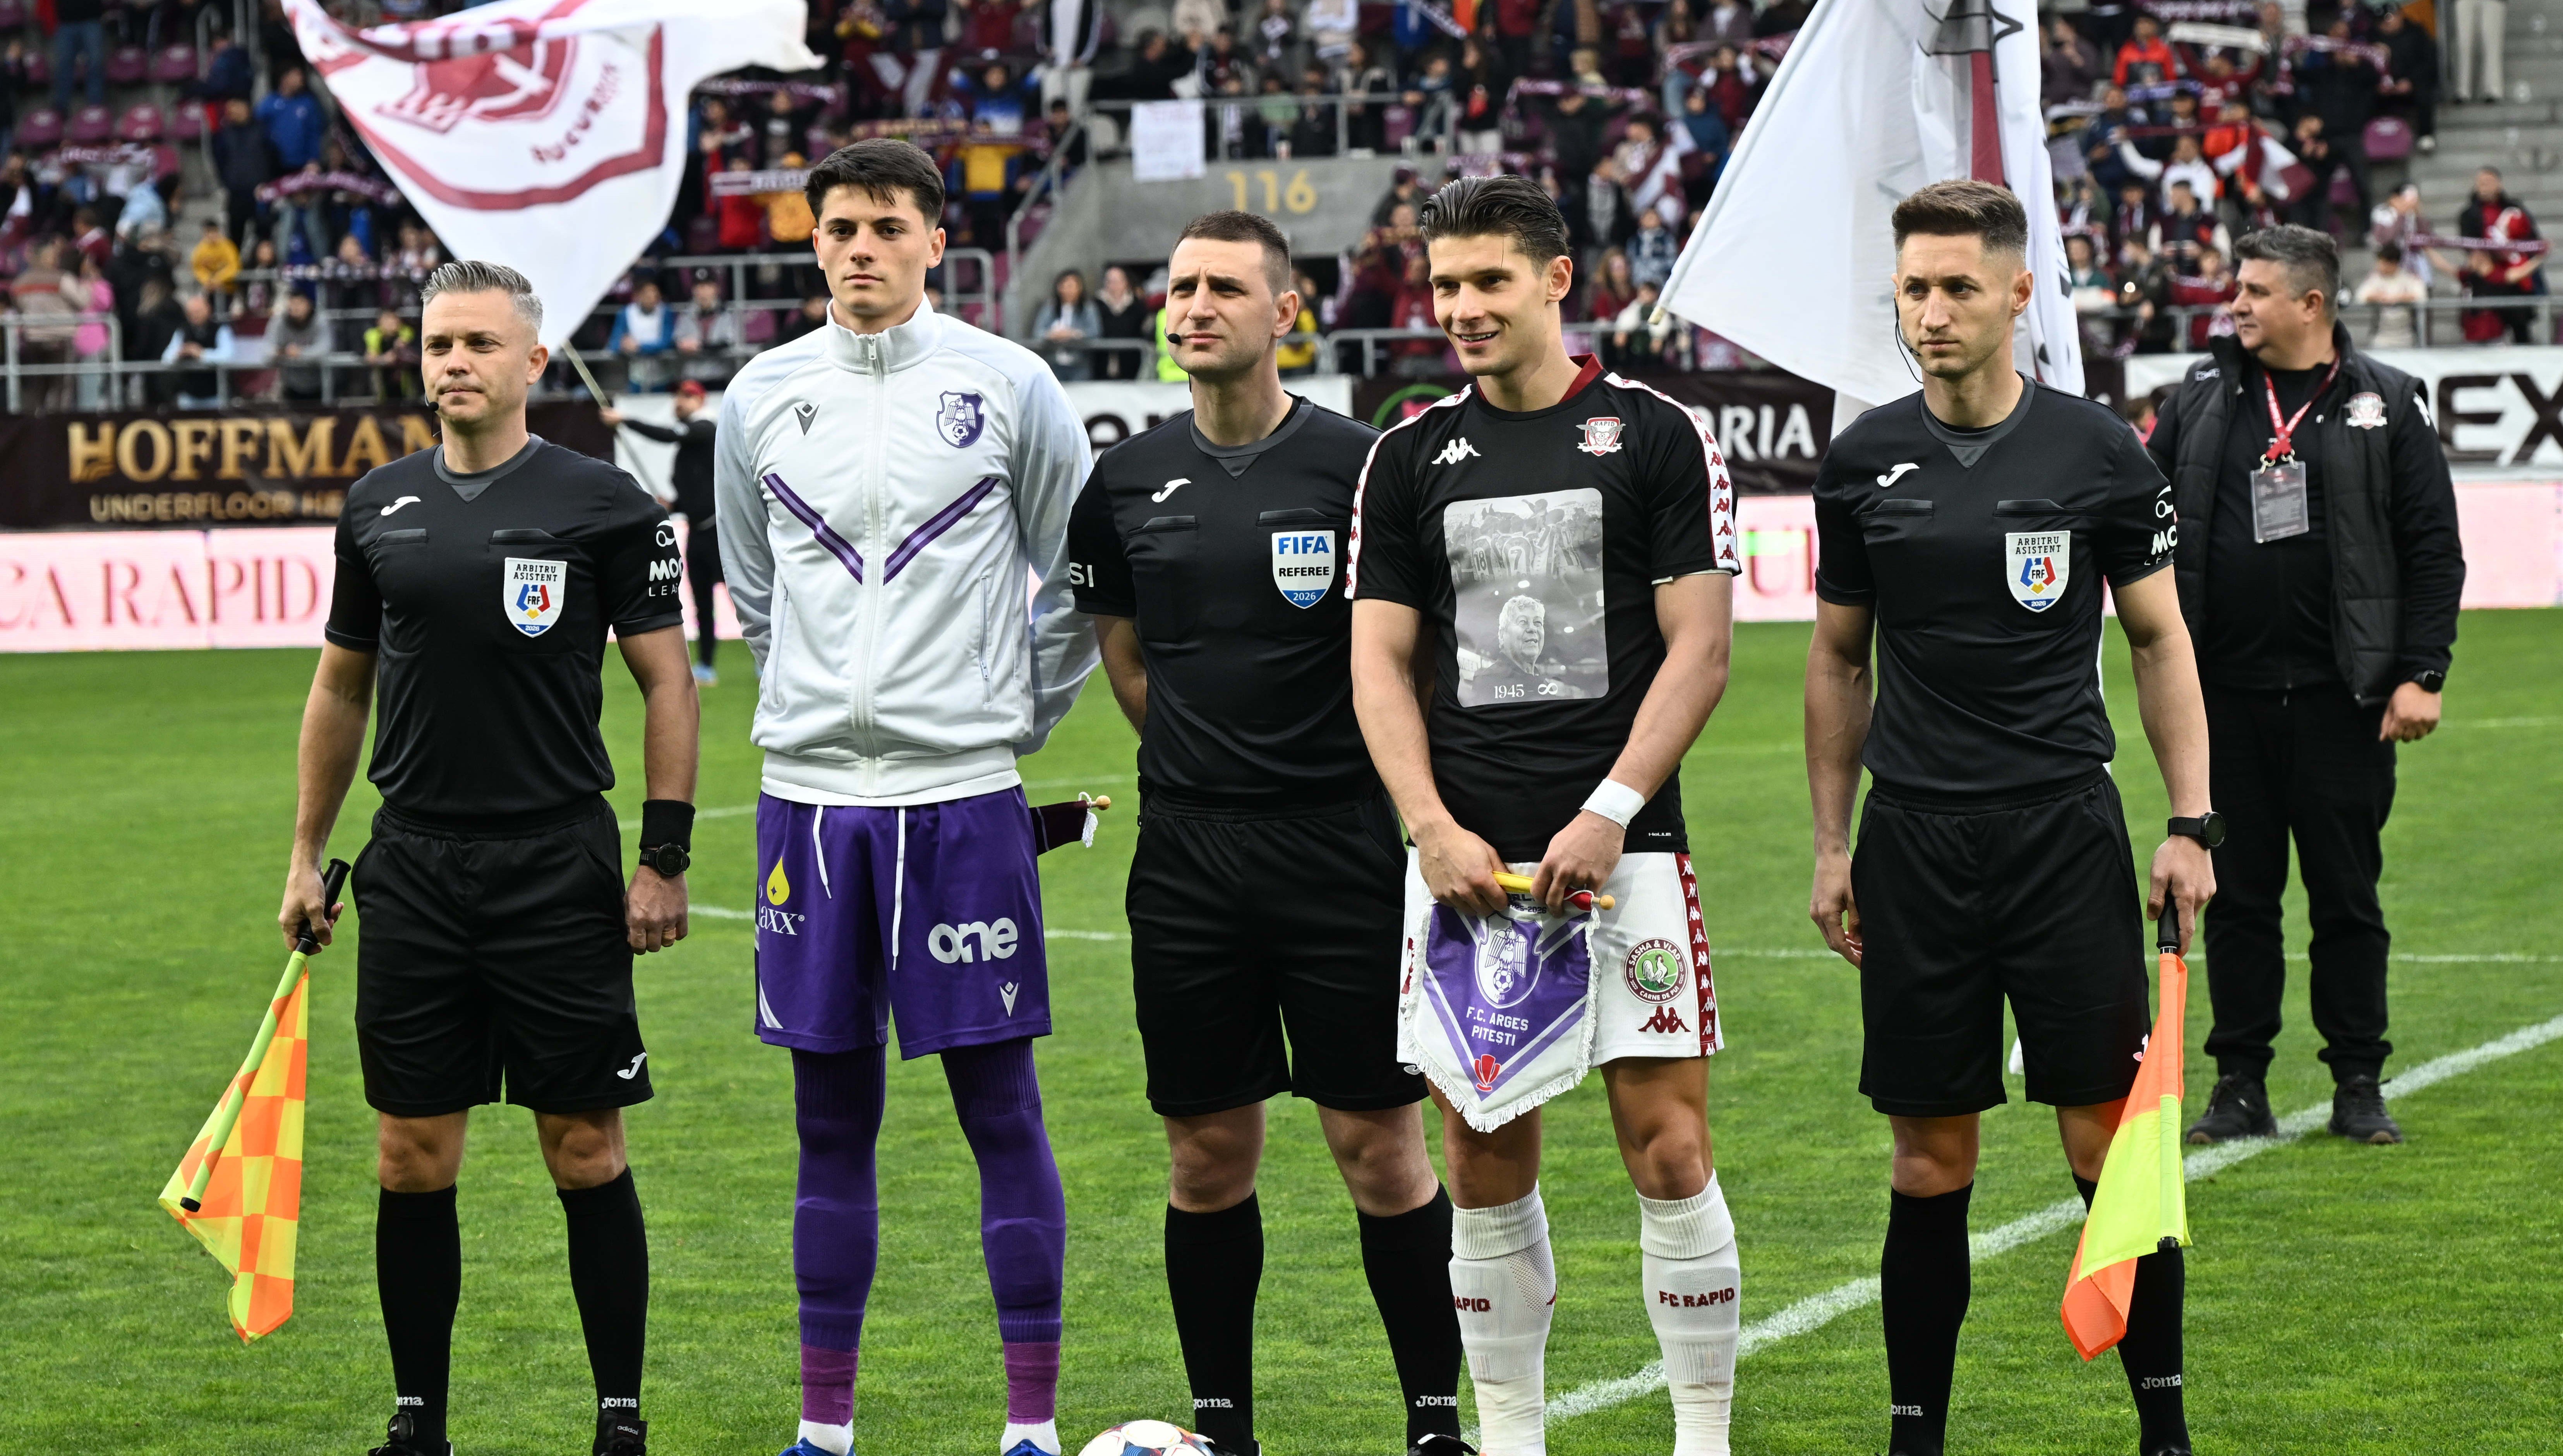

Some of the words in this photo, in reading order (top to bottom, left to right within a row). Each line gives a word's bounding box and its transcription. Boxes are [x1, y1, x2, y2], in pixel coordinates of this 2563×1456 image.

[1227, 170, 1315, 213] 116
[90, 490, 293, 522] UNDERFLOOR
[1278, 536, 1330, 555] FIFA
[2017, 536, 2059, 546] ARBITRU
[2016, 545, 2061, 555] ASISTENT
[1474, 550, 1487, 572] 18
[1510, 549, 1522, 570] 7
[516, 564, 556, 573] ARBITRU
[1069, 562, 1094, 588] SI
[1279, 566, 1330, 577] REFEREE
[2031, 569, 2045, 579] FRF
[513, 572, 558, 582] ASISTENT
[101, 558, 320, 626] RAPID
[1293, 592, 1316, 601] 2026
[527, 596, 541, 605] FRF
[1494, 684, 1525, 699] 1945
[928, 917, 1018, 964] one
[1628, 942, 1652, 966] SASHA
[1664, 941, 1681, 960] VLAD
[1640, 990, 1661, 1000] CARNE
[1670, 985, 1680, 996] PUI
[1466, 1006, 1486, 1022] F.C.
[1659, 1290, 1680, 1307] FC
[1683, 1287, 1735, 1307] RAPID
[2141, 1374, 2182, 1389] Joma
[396, 1396, 424, 1406] oma
[601, 1397, 637, 1409] Joma
[1415, 1395, 1457, 1407] Joma
[1891, 1404, 1923, 1417] oma
